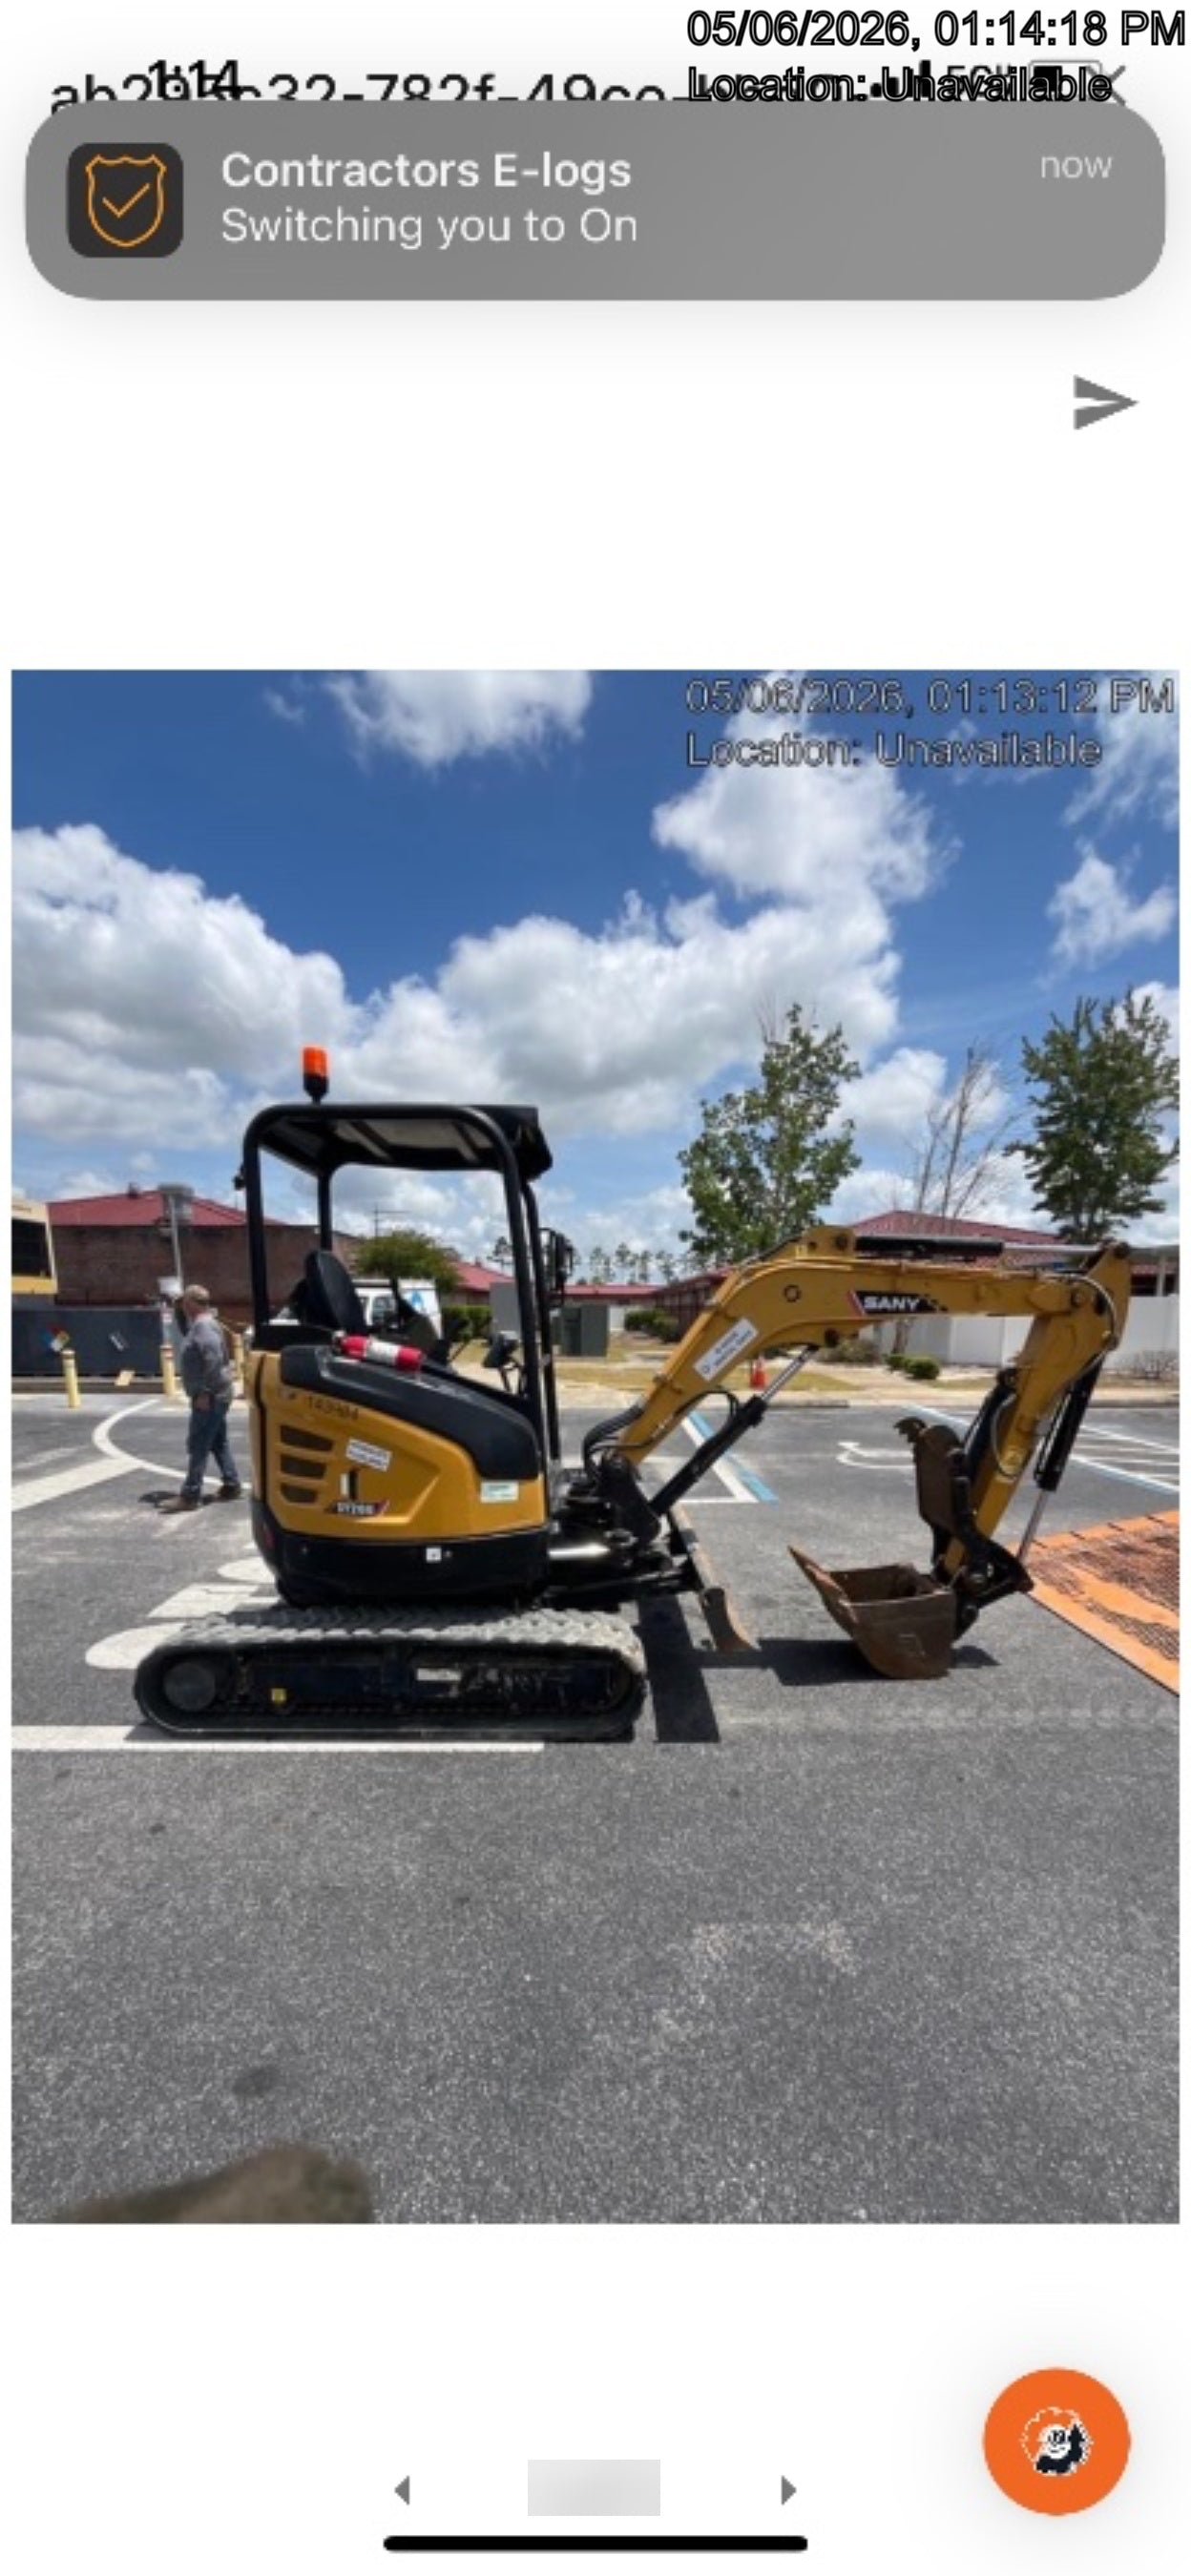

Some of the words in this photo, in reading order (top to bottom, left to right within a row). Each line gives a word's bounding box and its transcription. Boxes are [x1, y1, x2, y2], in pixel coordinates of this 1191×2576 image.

[148, 59, 239, 99] 1:14
[221, 151, 480, 188] Contractors
[493, 151, 632, 195] E-logs
[1040, 156, 1113, 178] now
[221, 206, 423, 250] Switching
[437, 216, 512, 250] you
[524, 209, 566, 242] to
[579, 207, 637, 242] On
[863, 1295, 921, 1313] SANY
